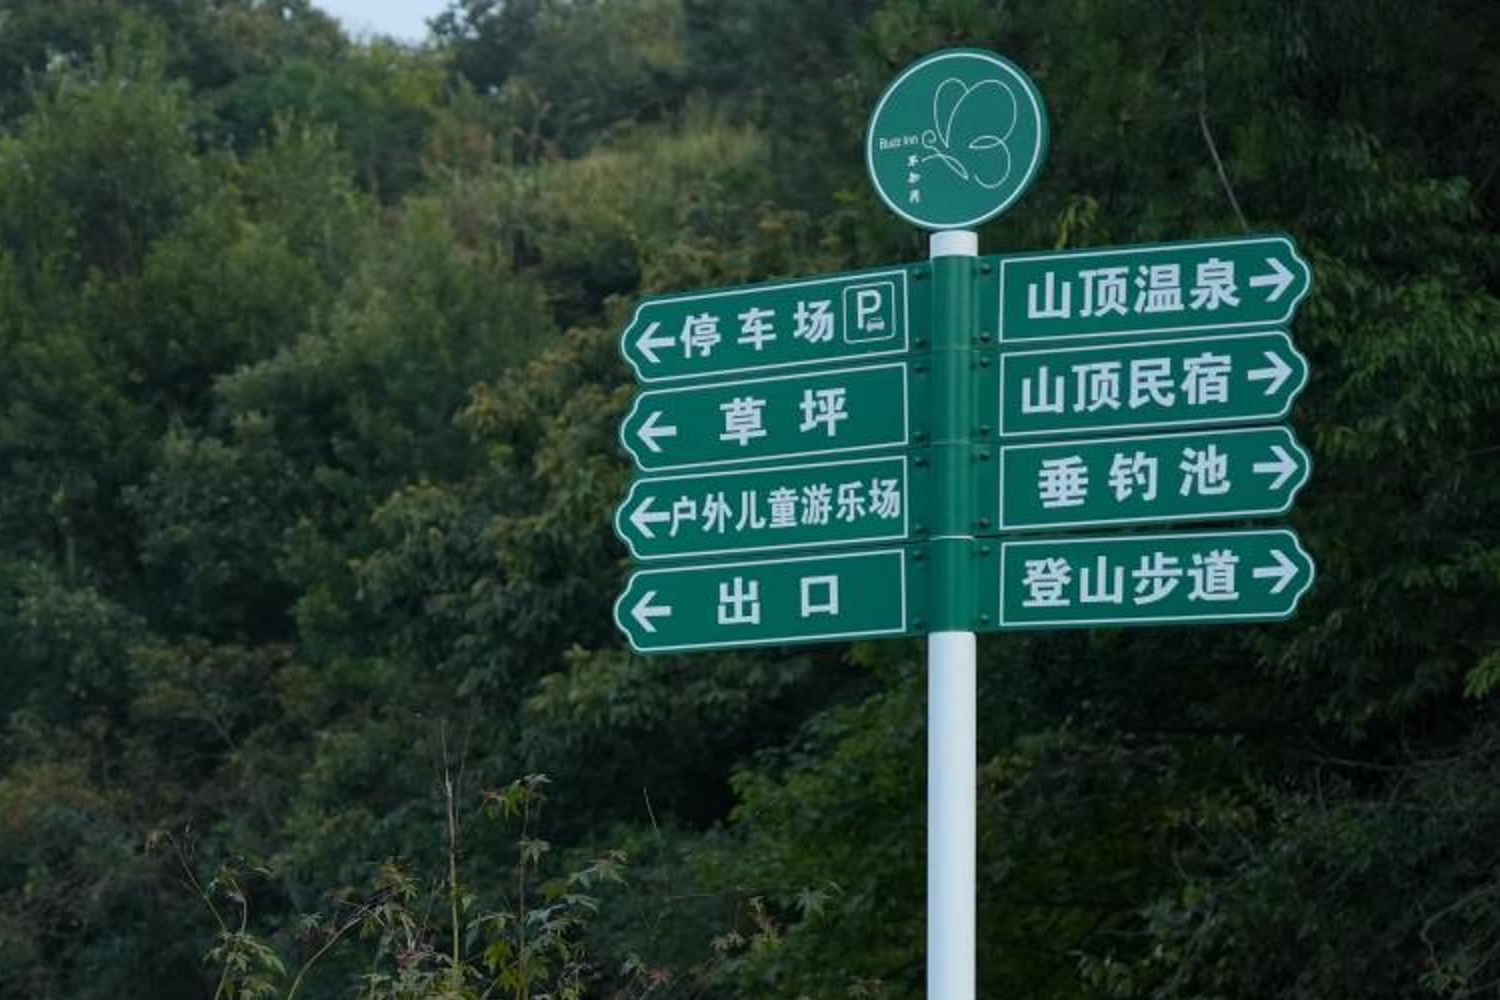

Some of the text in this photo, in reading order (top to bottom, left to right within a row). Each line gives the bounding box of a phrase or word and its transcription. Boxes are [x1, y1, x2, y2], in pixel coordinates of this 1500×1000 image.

[1027, 257, 1241, 320] 山顶温泉
[680, 289, 882, 359] 停车场 P
[1021, 352, 1232, 415] 山顶民宿
[719, 387, 849, 446] 草坪
[1037, 443, 1232, 509] 垂钓池
[669, 478, 901, 538] 户外儿童游乐场
[717, 575, 839, 626] 出口
[1022, 549, 1241, 608] 登山步道
